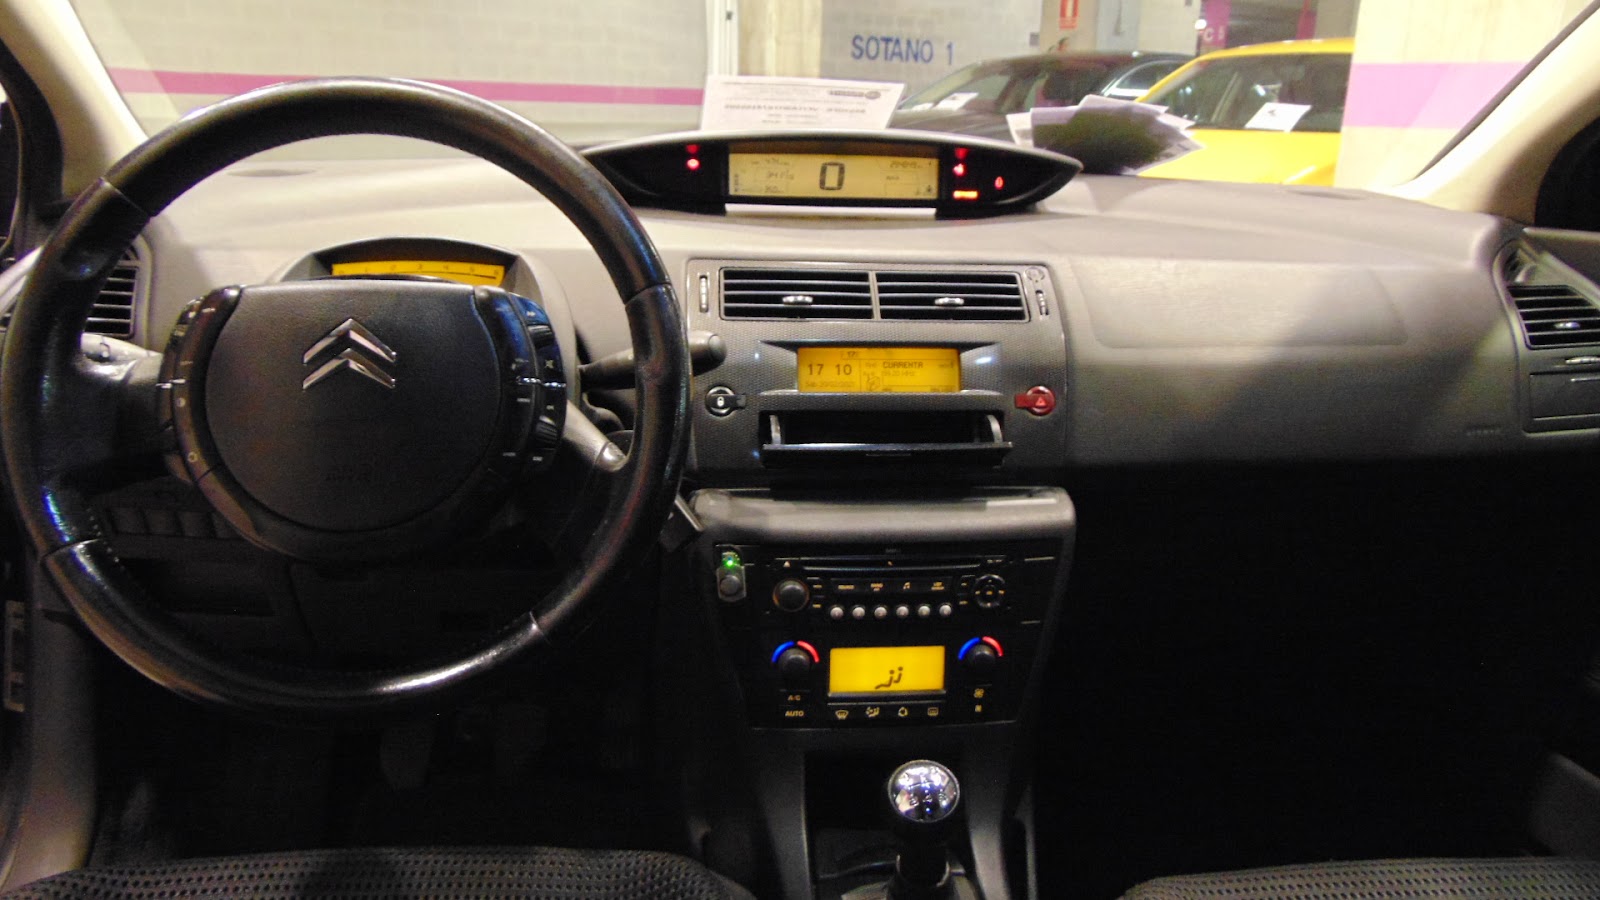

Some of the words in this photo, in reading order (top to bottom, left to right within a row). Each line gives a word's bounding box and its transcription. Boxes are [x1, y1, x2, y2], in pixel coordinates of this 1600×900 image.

[851, 34, 934, 63] SOTANO
[946, 41, 955, 65] 1
[819, 161, 845, 191] 0
[808, 364, 824, 376] 17
[836, 364, 852, 376] 10
